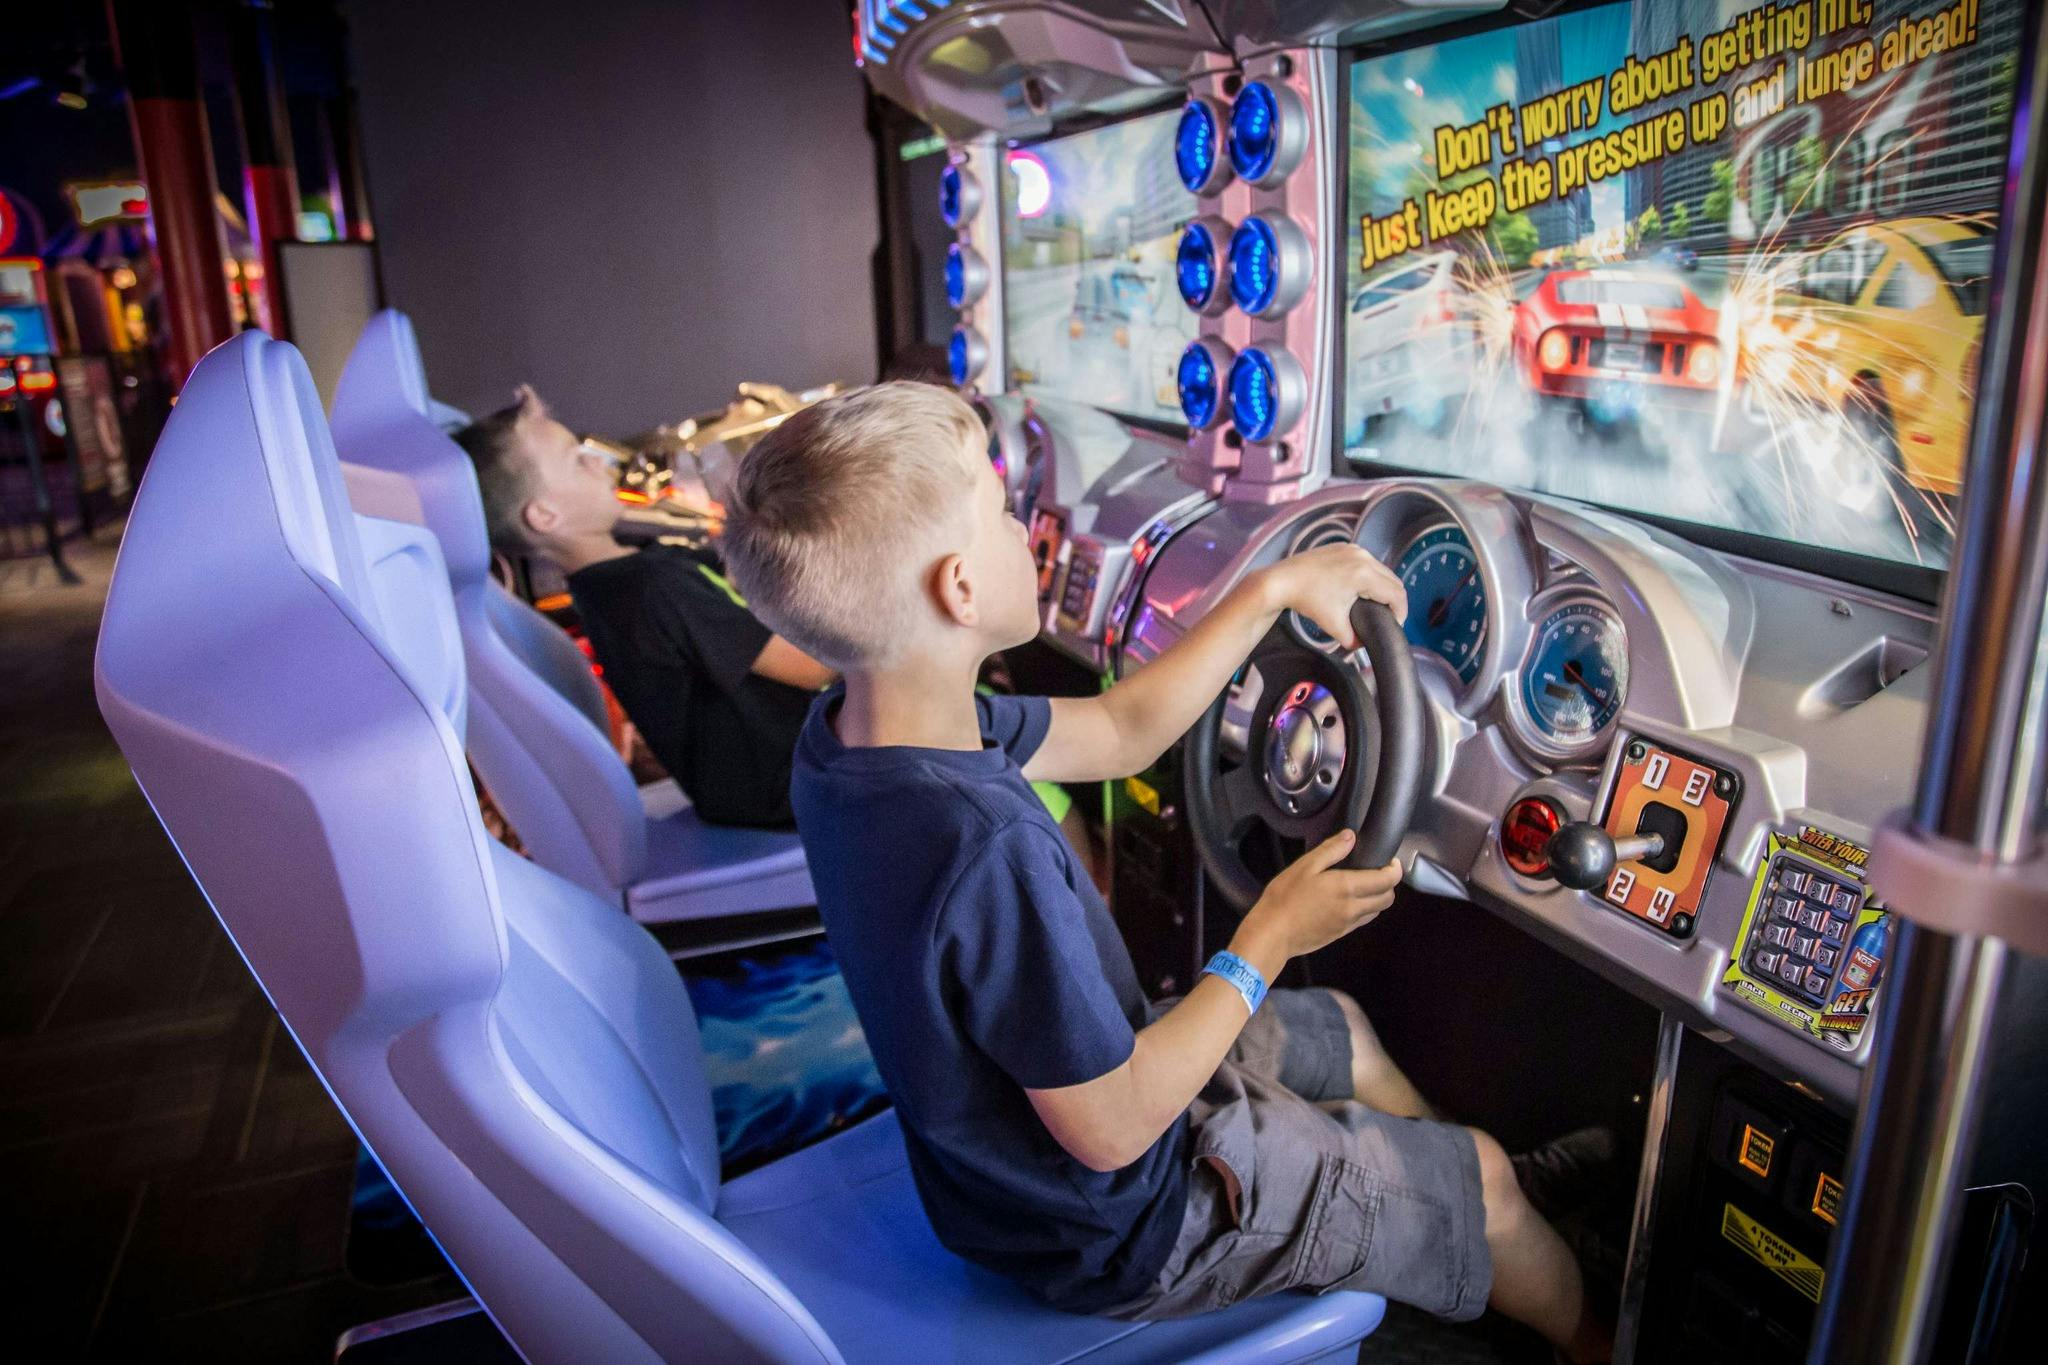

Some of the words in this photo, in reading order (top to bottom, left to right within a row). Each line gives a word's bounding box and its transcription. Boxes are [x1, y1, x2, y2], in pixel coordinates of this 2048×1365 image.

[1435, 102, 1517, 180] Don't
[1520, 76, 1605, 148] worry
[1609, 38, 1694, 114] about
[1702, 1, 1812, 84] getting
[1361, 198, 1421, 271] just
[1426, 179, 1496, 241] keep
[1501, 157, 1552, 213] the
[1557, 108, 1685, 198] pressure
[1690, 91, 1728, 144] up
[1734, 62, 1785, 128] and
[1797, 38, 1875, 103] lunge
[1881, 0, 1979, 72] ahead!
[1424, 559, 1432, 572] 3
[1440, 553, 1448, 566] 4
[1458, 558, 1466, 570] 5
[1410, 573, 1418, 587] 2
[1469, 575, 1477, 586] 6
[1475, 595, 1483, 607] 7
[1470, 620, 1478, 632] 8
[1461, 643, 1469, 656] 9
[1595, 687, 1607, 699] 120
[1685, 772, 1707, 801] 3
[1802, 831, 1834, 850] ENTER
[1833, 842, 1867, 865] YOUR
[1611, 871, 1629, 899] 2
[1653, 889, 1670, 918] 4
[1741, 980, 1766, 998] BACK
[1832, 989, 1872, 1013] GET
[1780, 1001, 1814, 1023] DECIDE
[1760, 1230, 1796, 1262] TOKENS
[1764, 1246, 1788, 1266] PLAY
